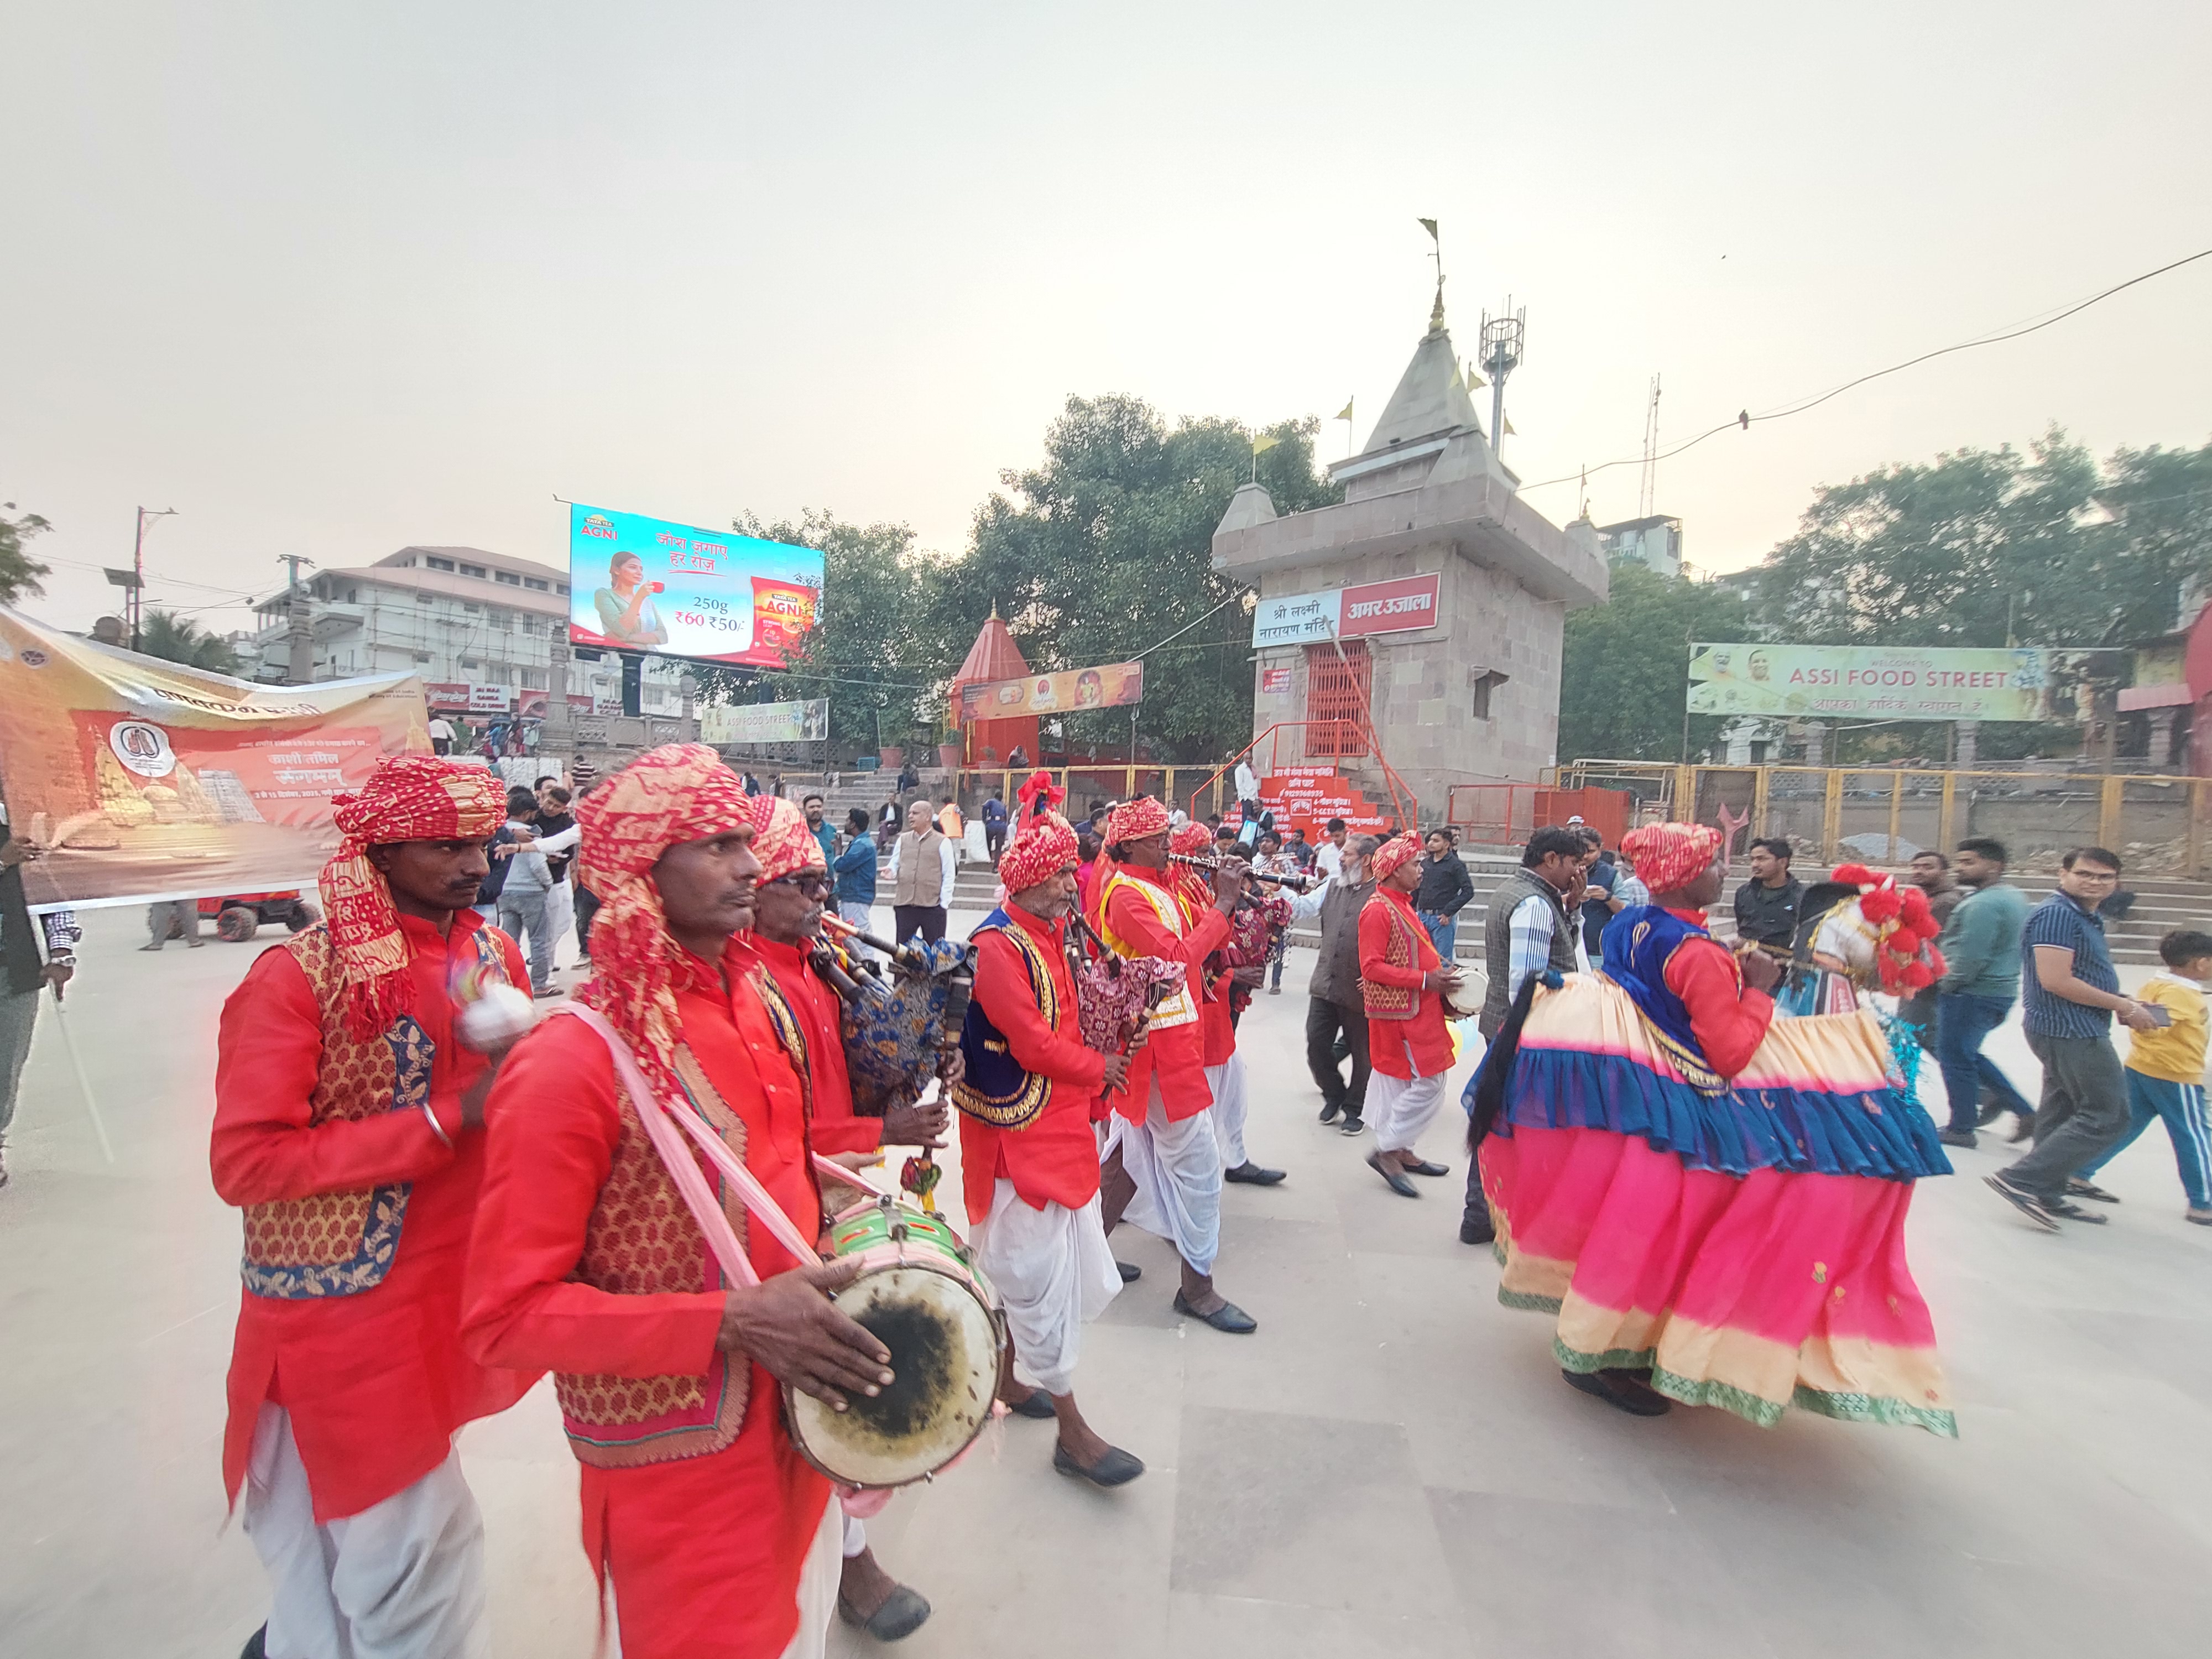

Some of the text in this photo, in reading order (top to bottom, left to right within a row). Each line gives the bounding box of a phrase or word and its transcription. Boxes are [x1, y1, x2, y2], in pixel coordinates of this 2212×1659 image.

[581, 525, 617, 540] AGNI
[656, 531, 728, 560] जोश जगाए
[669, 551, 716, 571] हर रोज़
[693, 597, 728, 614] 250g
[766, 601, 801, 617] AGNI
[1274, 599, 1321, 619] श्री लक्ष्मी
[1348, 593, 1432, 619] अमर उजाला
[1259, 624, 1301, 639] नारायण
[1789, 668, 2008, 688] ASSI FOOD STREET
[727, 713, 791, 727] ASSI FOOD STREET
[267, 751, 340, 764] काशी तमिल
